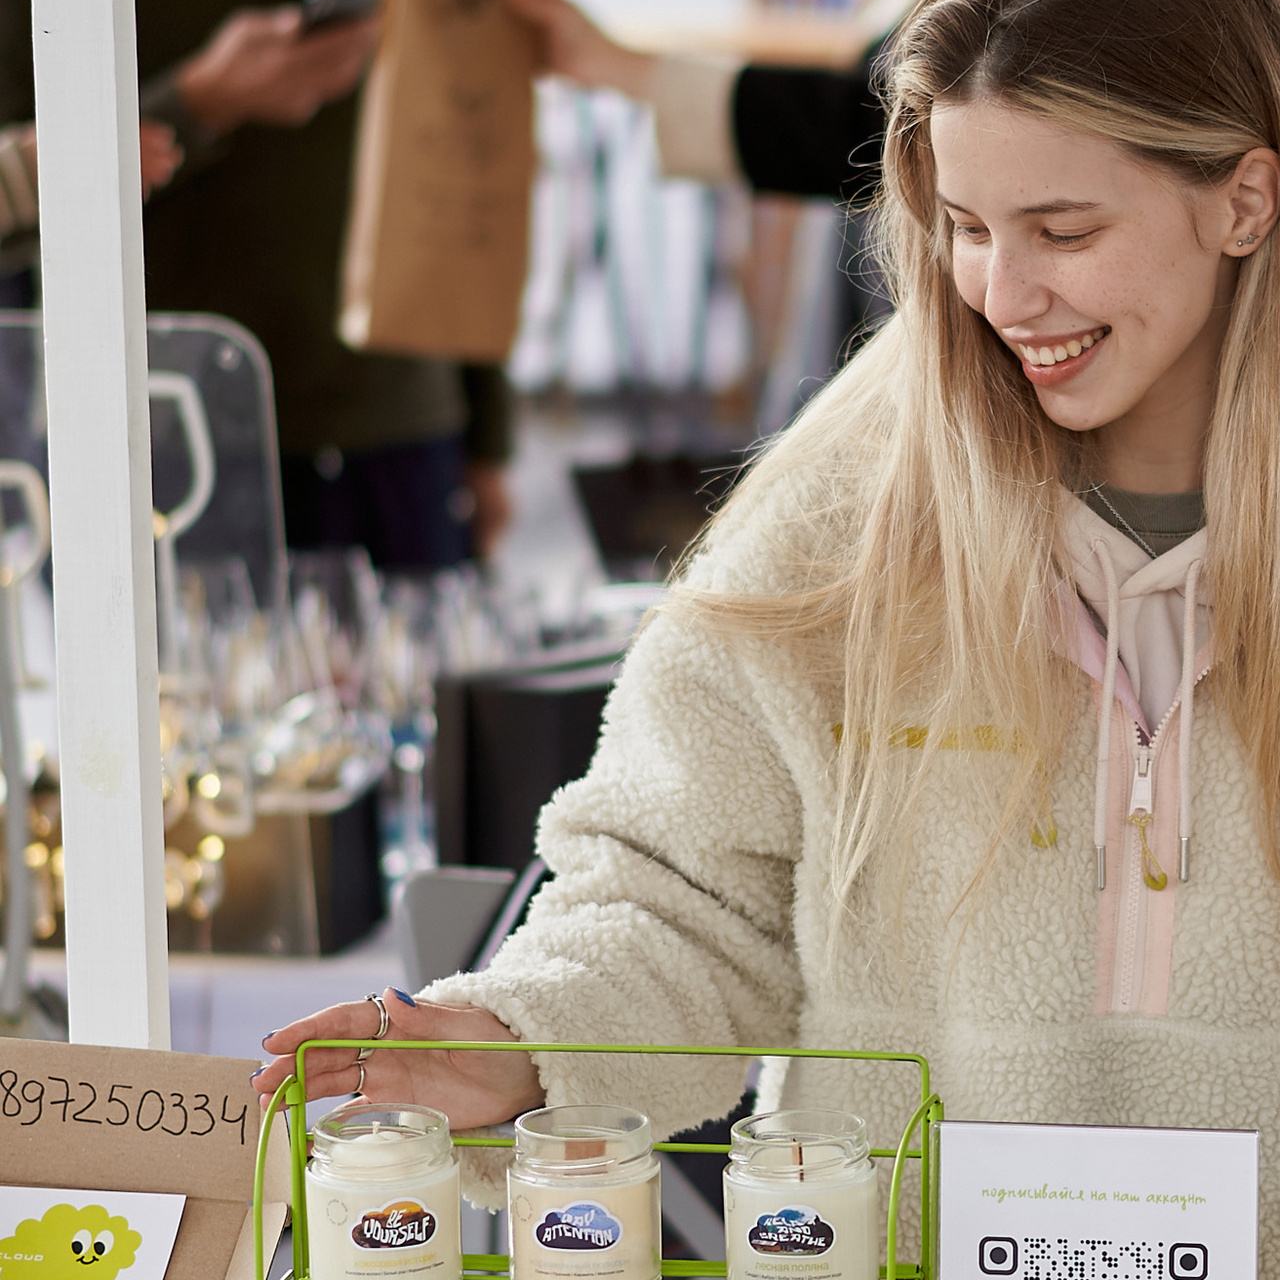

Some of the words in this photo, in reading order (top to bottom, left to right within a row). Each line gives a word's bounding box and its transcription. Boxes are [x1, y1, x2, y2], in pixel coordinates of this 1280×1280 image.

[0, 1069, 248, 1146] 897250334
[982, 1183, 1085, 1203] подписывайся
[1090, 1190, 1107, 1201] на
[1113, 1191, 1140, 1203] наш
[1145, 1193, 1207, 1211] аккаунт
[386, 1209, 408, 1228] BE
[363, 1215, 431, 1246] YOURSELF
[541, 1223, 614, 1247] ATTENTION
[758, 1232, 827, 1247] BREATHE
[0, 1252, 45, 1262] LOUD
[790, 1261, 830, 1272] поляна
